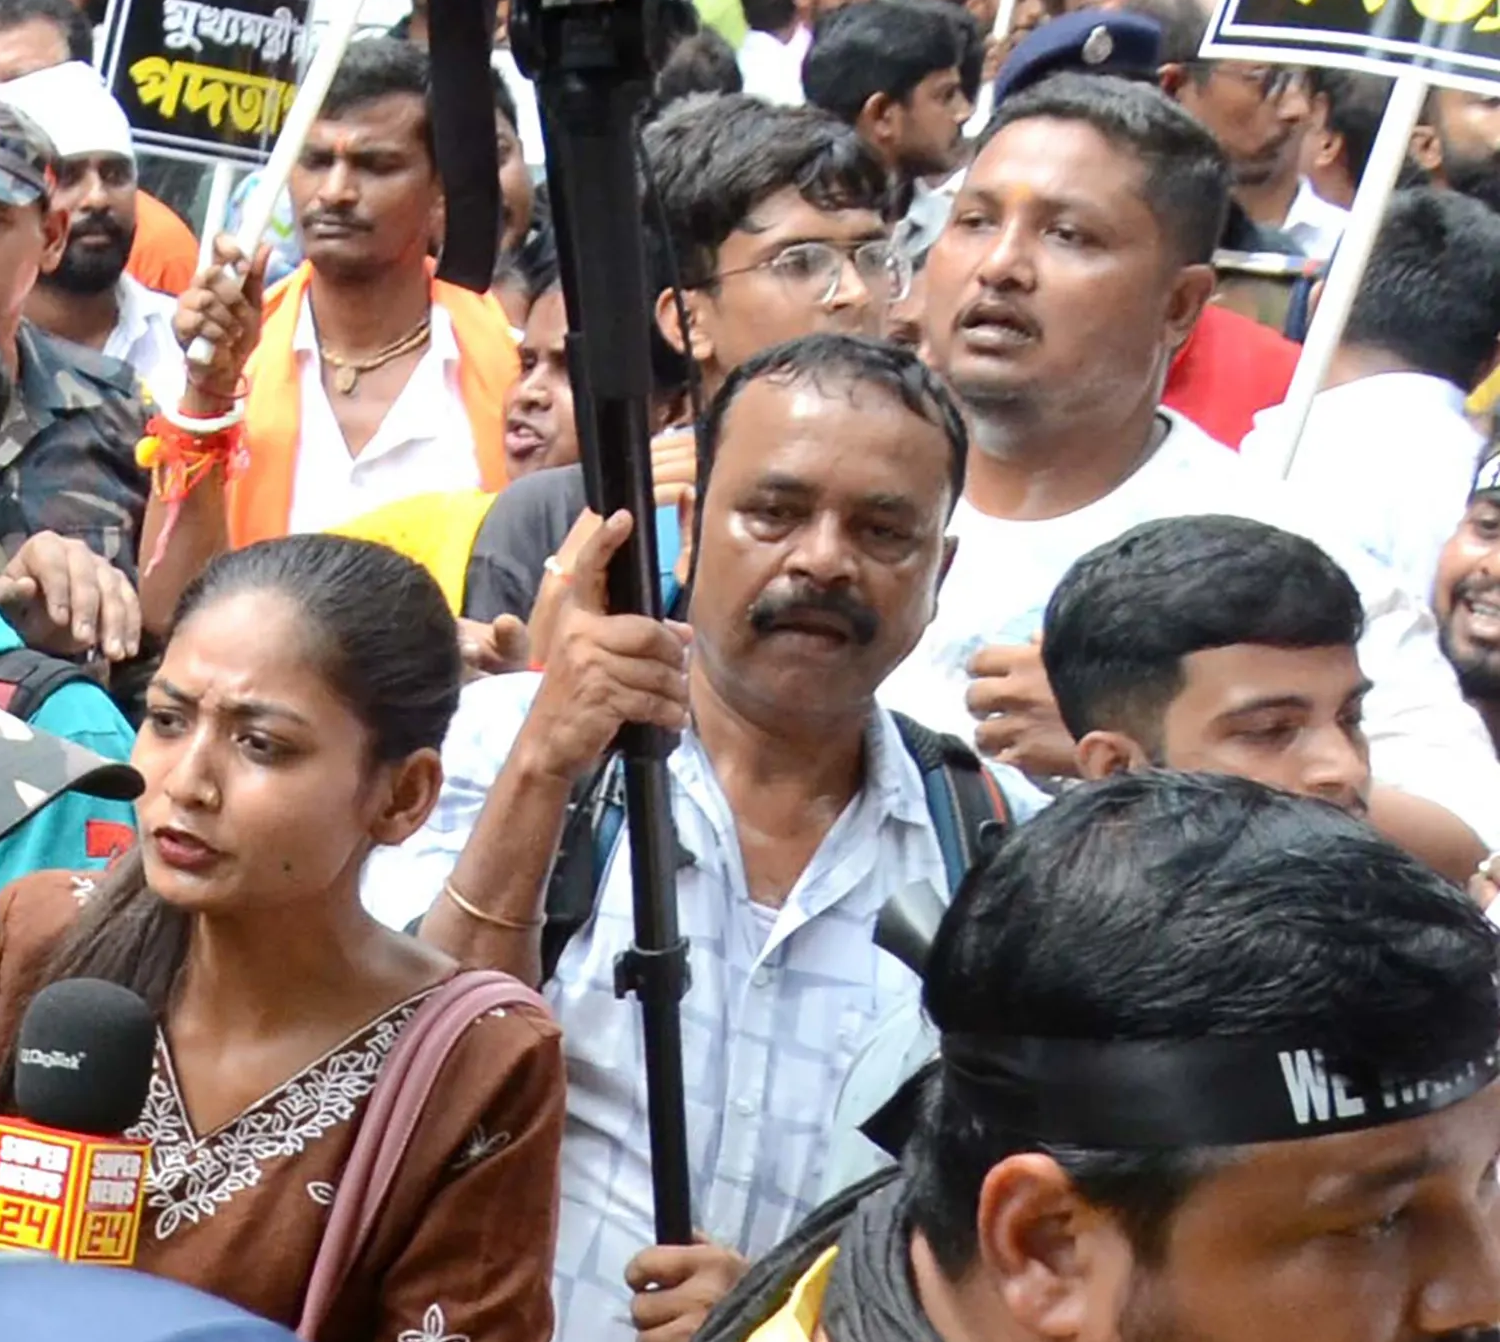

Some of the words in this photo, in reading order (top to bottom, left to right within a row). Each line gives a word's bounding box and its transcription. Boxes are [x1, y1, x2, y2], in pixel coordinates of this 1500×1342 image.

[0, 1134, 71, 1174] SUPER
[91, 1152, 143, 1179] SUPER
[87, 1178, 137, 1206] NEWS
[87, 1214, 125, 1254] 24
